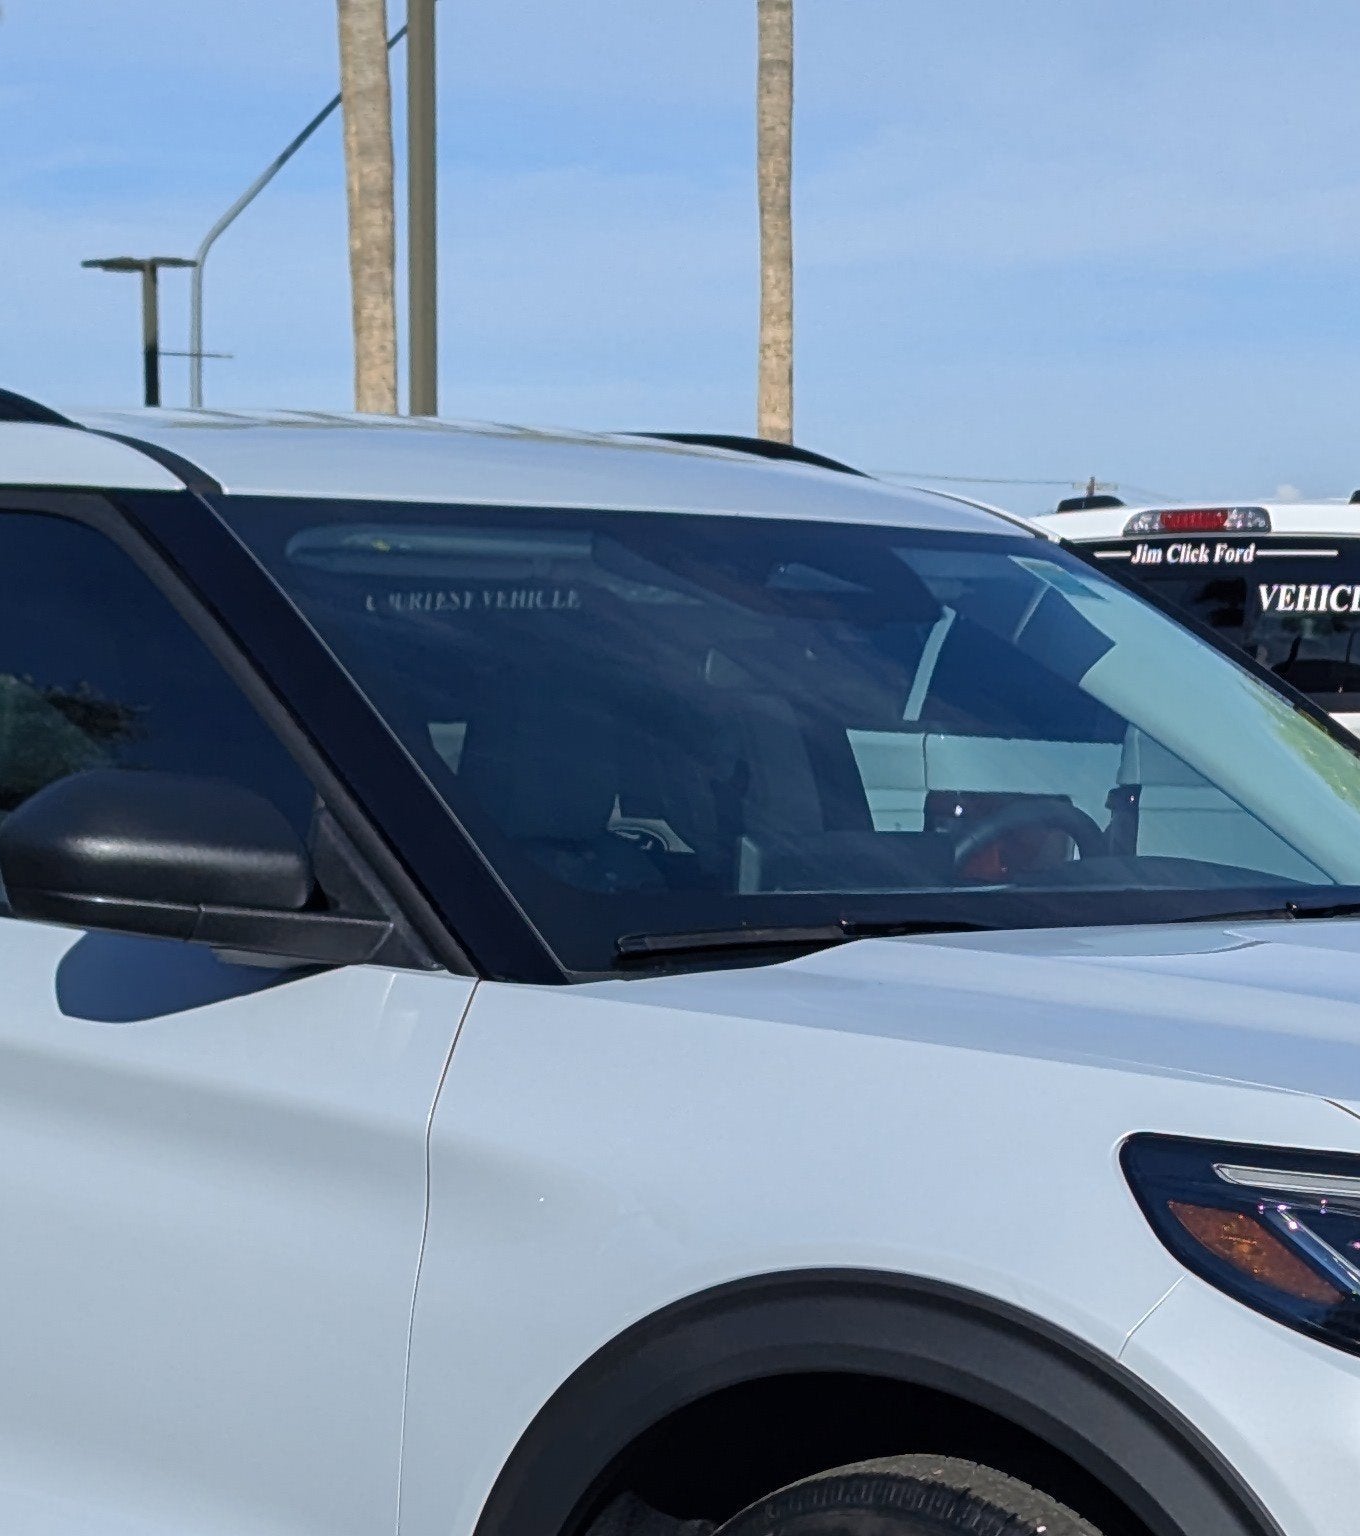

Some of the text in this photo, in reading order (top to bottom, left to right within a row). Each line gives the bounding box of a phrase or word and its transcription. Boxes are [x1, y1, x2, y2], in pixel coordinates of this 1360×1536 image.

[1131, 542, 1257, 564] Jim Click Ford
